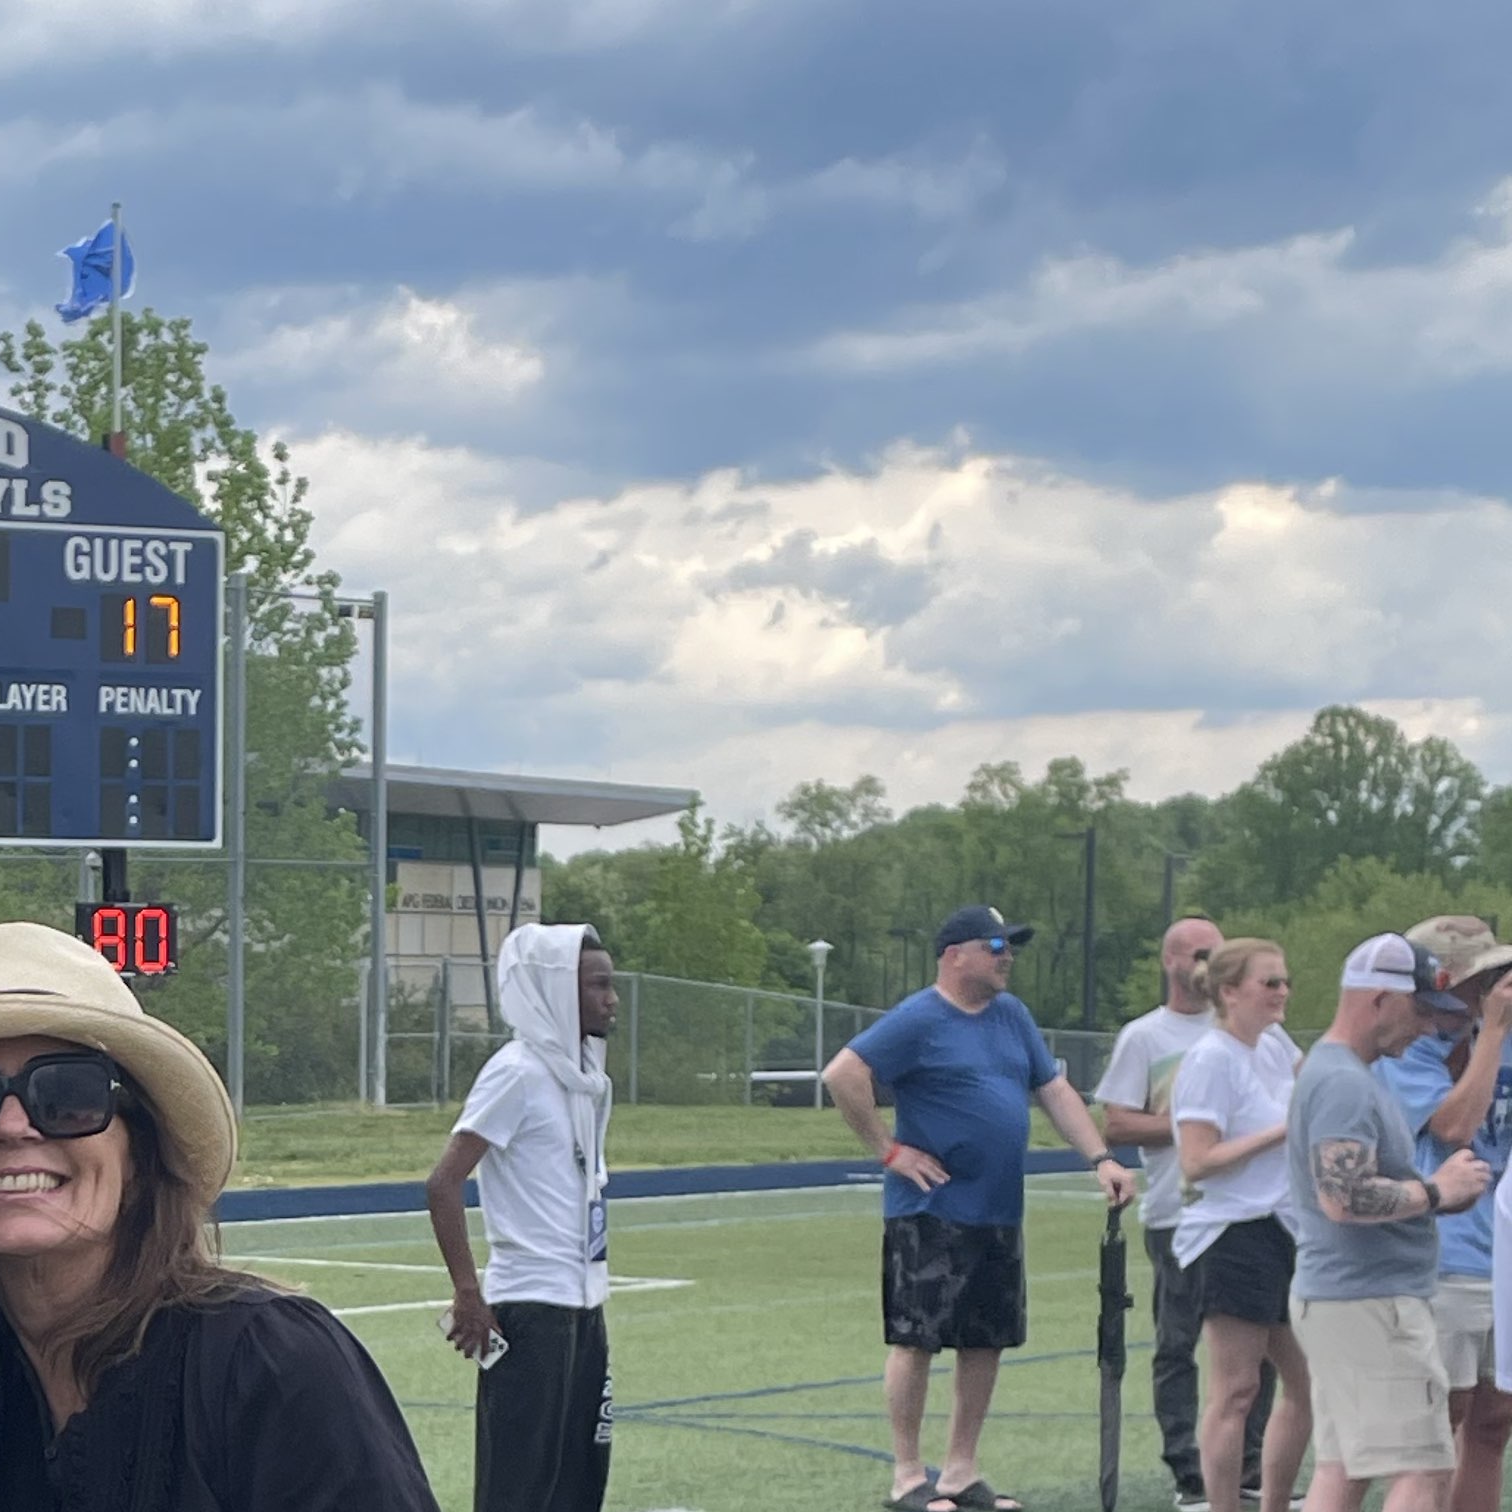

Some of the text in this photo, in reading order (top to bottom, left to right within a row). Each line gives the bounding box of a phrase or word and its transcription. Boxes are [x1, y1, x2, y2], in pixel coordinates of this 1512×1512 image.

[64, 535, 194, 585] GUEST
[122, 594, 181, 658] 17
[98, 685, 202, 716] PENALTY
[92, 908, 169, 974] 80
